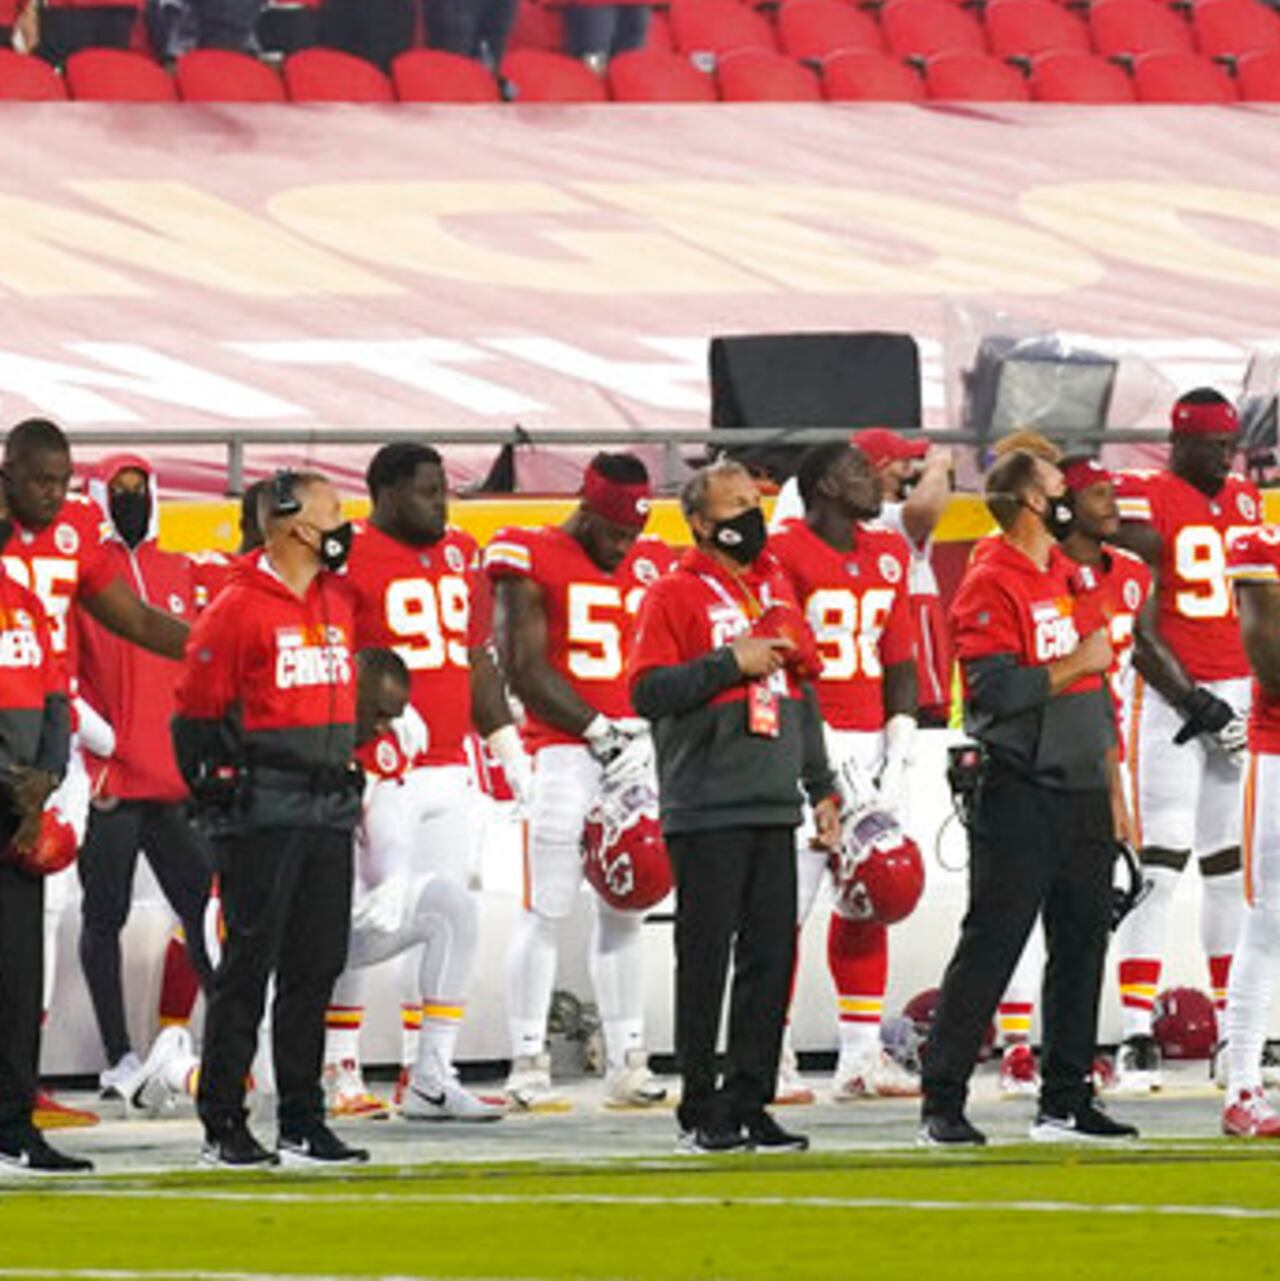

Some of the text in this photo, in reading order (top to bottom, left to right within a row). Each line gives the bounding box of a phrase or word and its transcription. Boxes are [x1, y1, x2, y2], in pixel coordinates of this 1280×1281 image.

[1, 555, 78, 652] 5
[385, 574, 470, 670] 99
[567, 582, 647, 680] 5
[275, 646, 352, 690] CHIEFS
